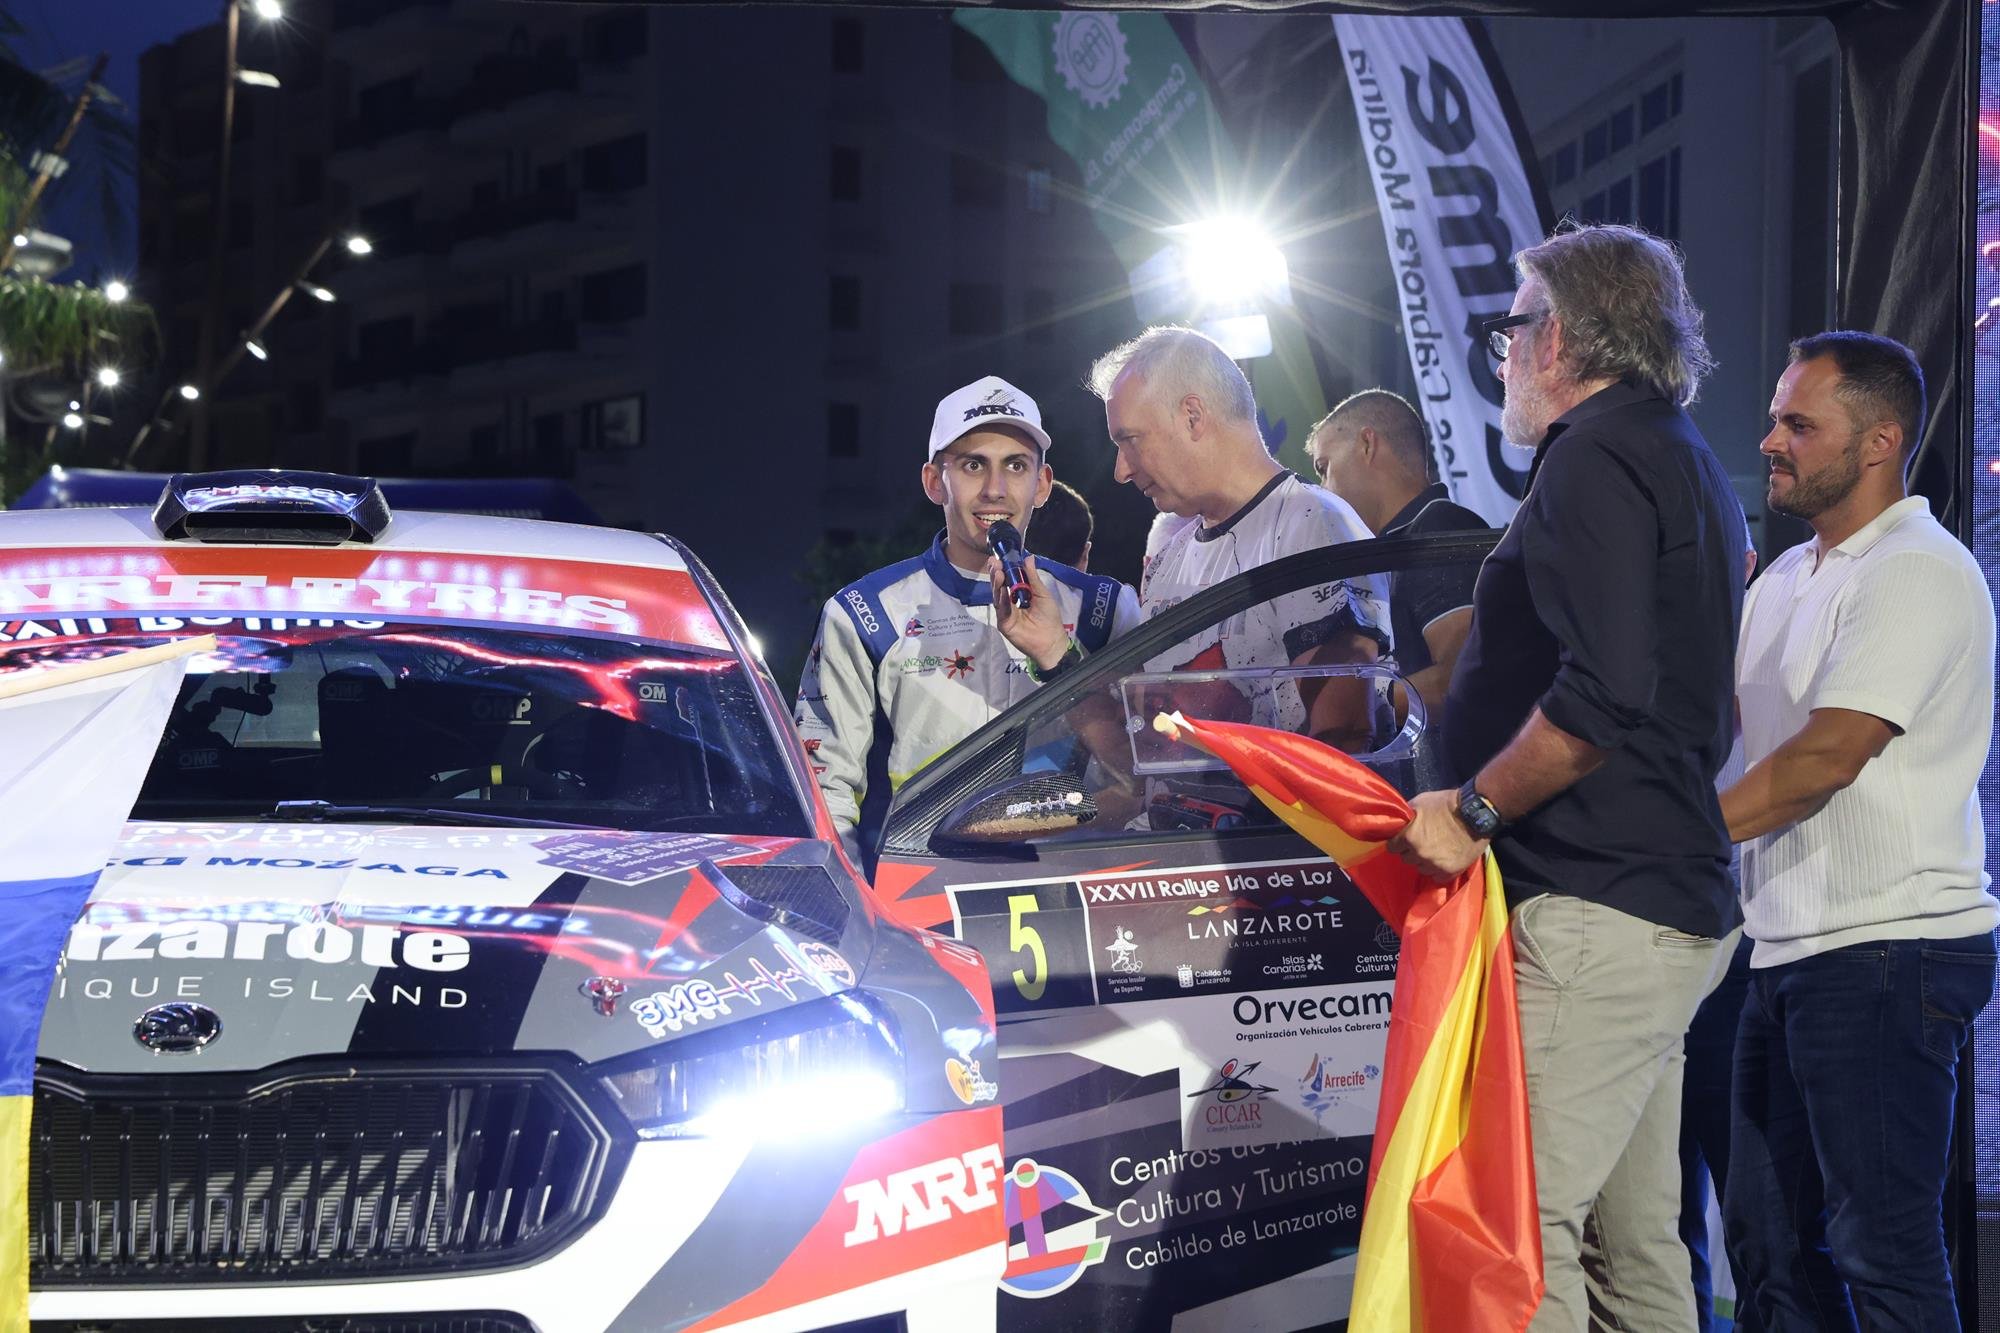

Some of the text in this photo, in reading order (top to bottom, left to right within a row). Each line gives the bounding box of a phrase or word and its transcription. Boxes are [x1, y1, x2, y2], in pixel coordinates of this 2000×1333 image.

[963, 404, 1025, 422] MRF
[291, 576, 627, 625] TYRES
[846, 589, 880, 635] sparco
[1090, 583, 1112, 628] sparco
[205, 856, 510, 880] MOZAGA
[1087, 881, 1155, 903] XXVII
[1161, 878, 1220, 898] Rallye
[1225, 874, 1259, 891] Isla
[1267, 871, 1294, 887] de
[1301, 869, 1332, 886] Los
[1188, 911, 1344, 940] LANZAROTE
[1008, 893, 1048, 1001] 5
[1242, 939, 1260, 948] ISLA
[1263, 936, 1308, 947] DIFERENTE
[1195, 968, 1221, 978] Cabildo
[1262, 964, 1306, 976] Canarias
[1282, 955, 1306, 966] Islas
[1355, 964, 1389, 973] Cultura
[1356, 954, 1394, 964] Centros
[58, 976, 469, 1009] IQUE ISLAND
[1196, 976, 1231, 985] Lanzarote
[630, 980, 719, 1026] 3MG
[1233, 990, 1392, 1026] Orvecam
[1236, 1028, 1297, 1042] Organización
[1299, 1024, 1342, 1036] Vehículos
[1344, 1022, 1381, 1033] Cabrera
[1324, 1070, 1365, 1089] Arrecife
[1206, 1102, 1262, 1125] CICAR
[1110, 1150, 1221, 1186] Centros
[844, 1143, 1003, 1247] MRF
[1116, 1154, 1365, 1228] Cultura y Turismo
[1125, 1202, 1358, 1271] Cabildo de Lanzarote
